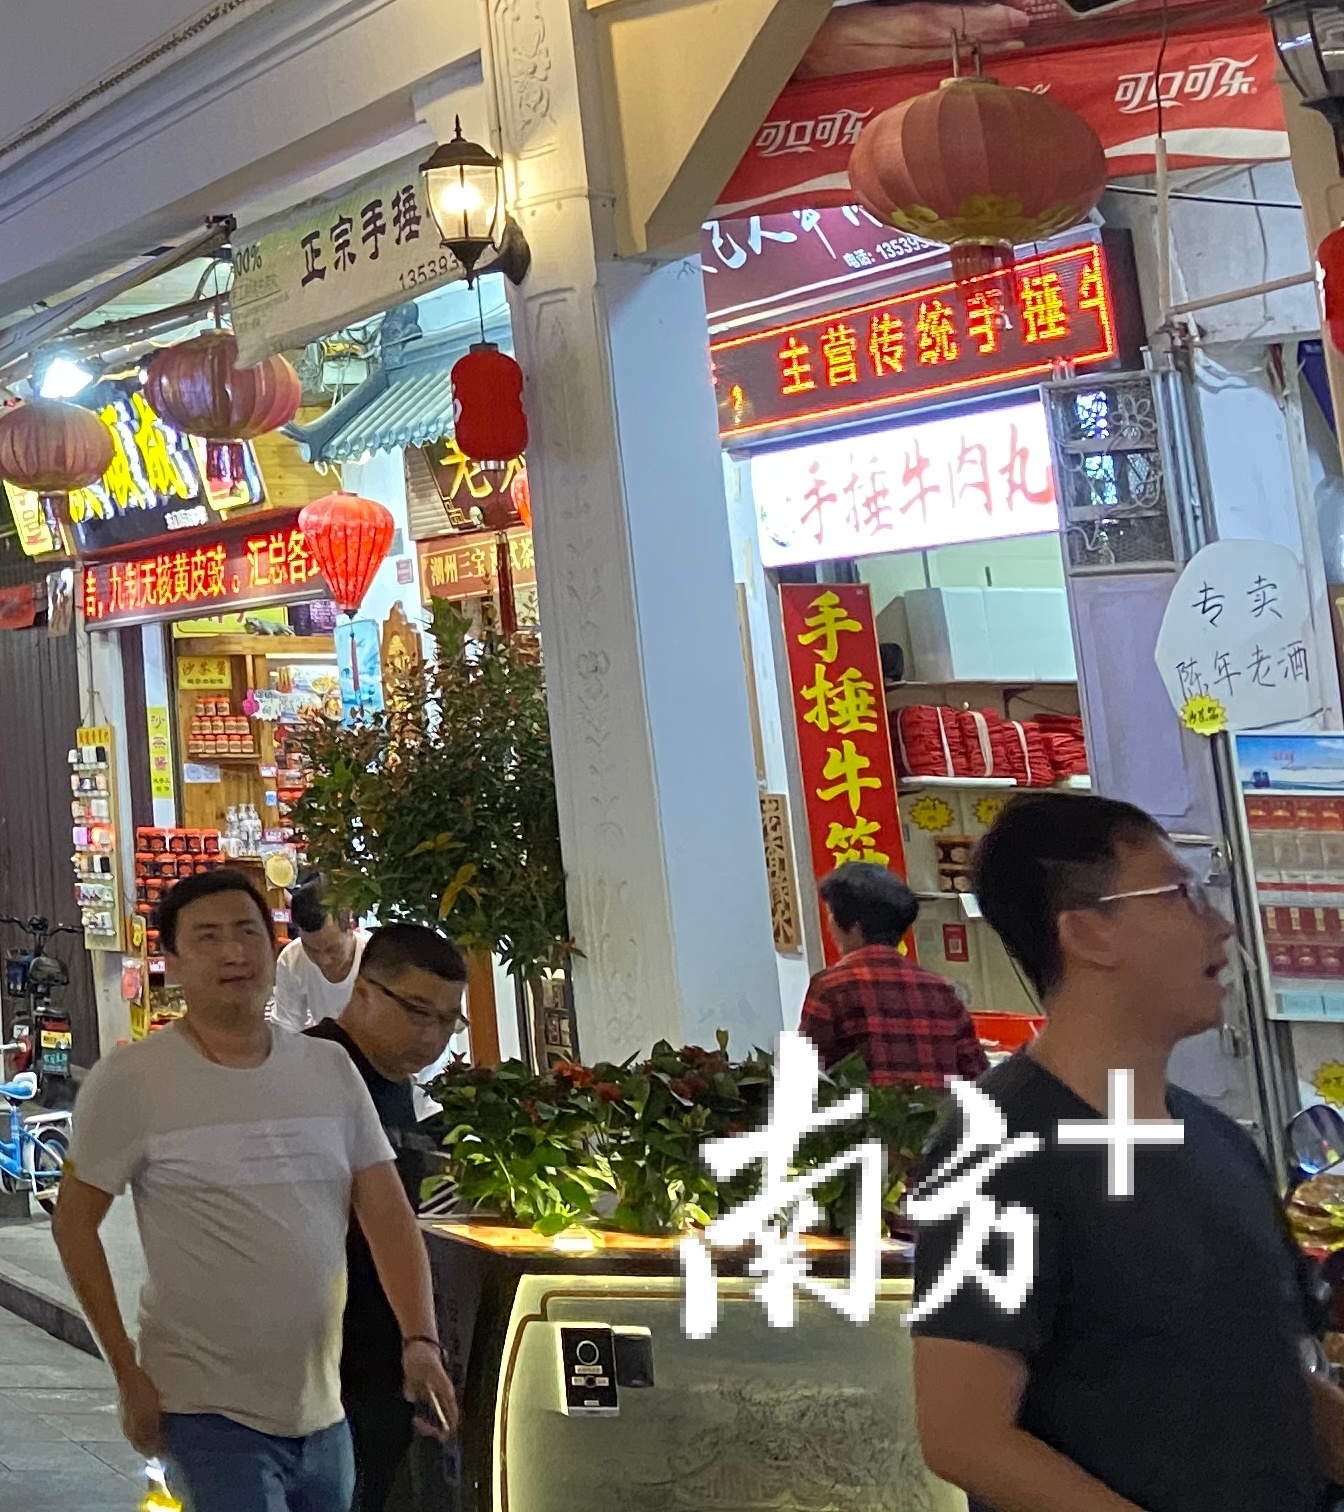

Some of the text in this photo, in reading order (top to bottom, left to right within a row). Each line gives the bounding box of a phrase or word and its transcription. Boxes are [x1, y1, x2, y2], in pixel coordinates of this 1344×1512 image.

[1114, 54, 1258, 114] 可口可乐
[300, 184, 424, 287] 正宗手捶
[800, 423, 1056, 546] 手捶牛肉丸
[1192, 574, 1283, 627] 专卖
[1175, 640, 1310, 704] 陈年老酒
[797, 590, 890, 867] 手捶牛筋
